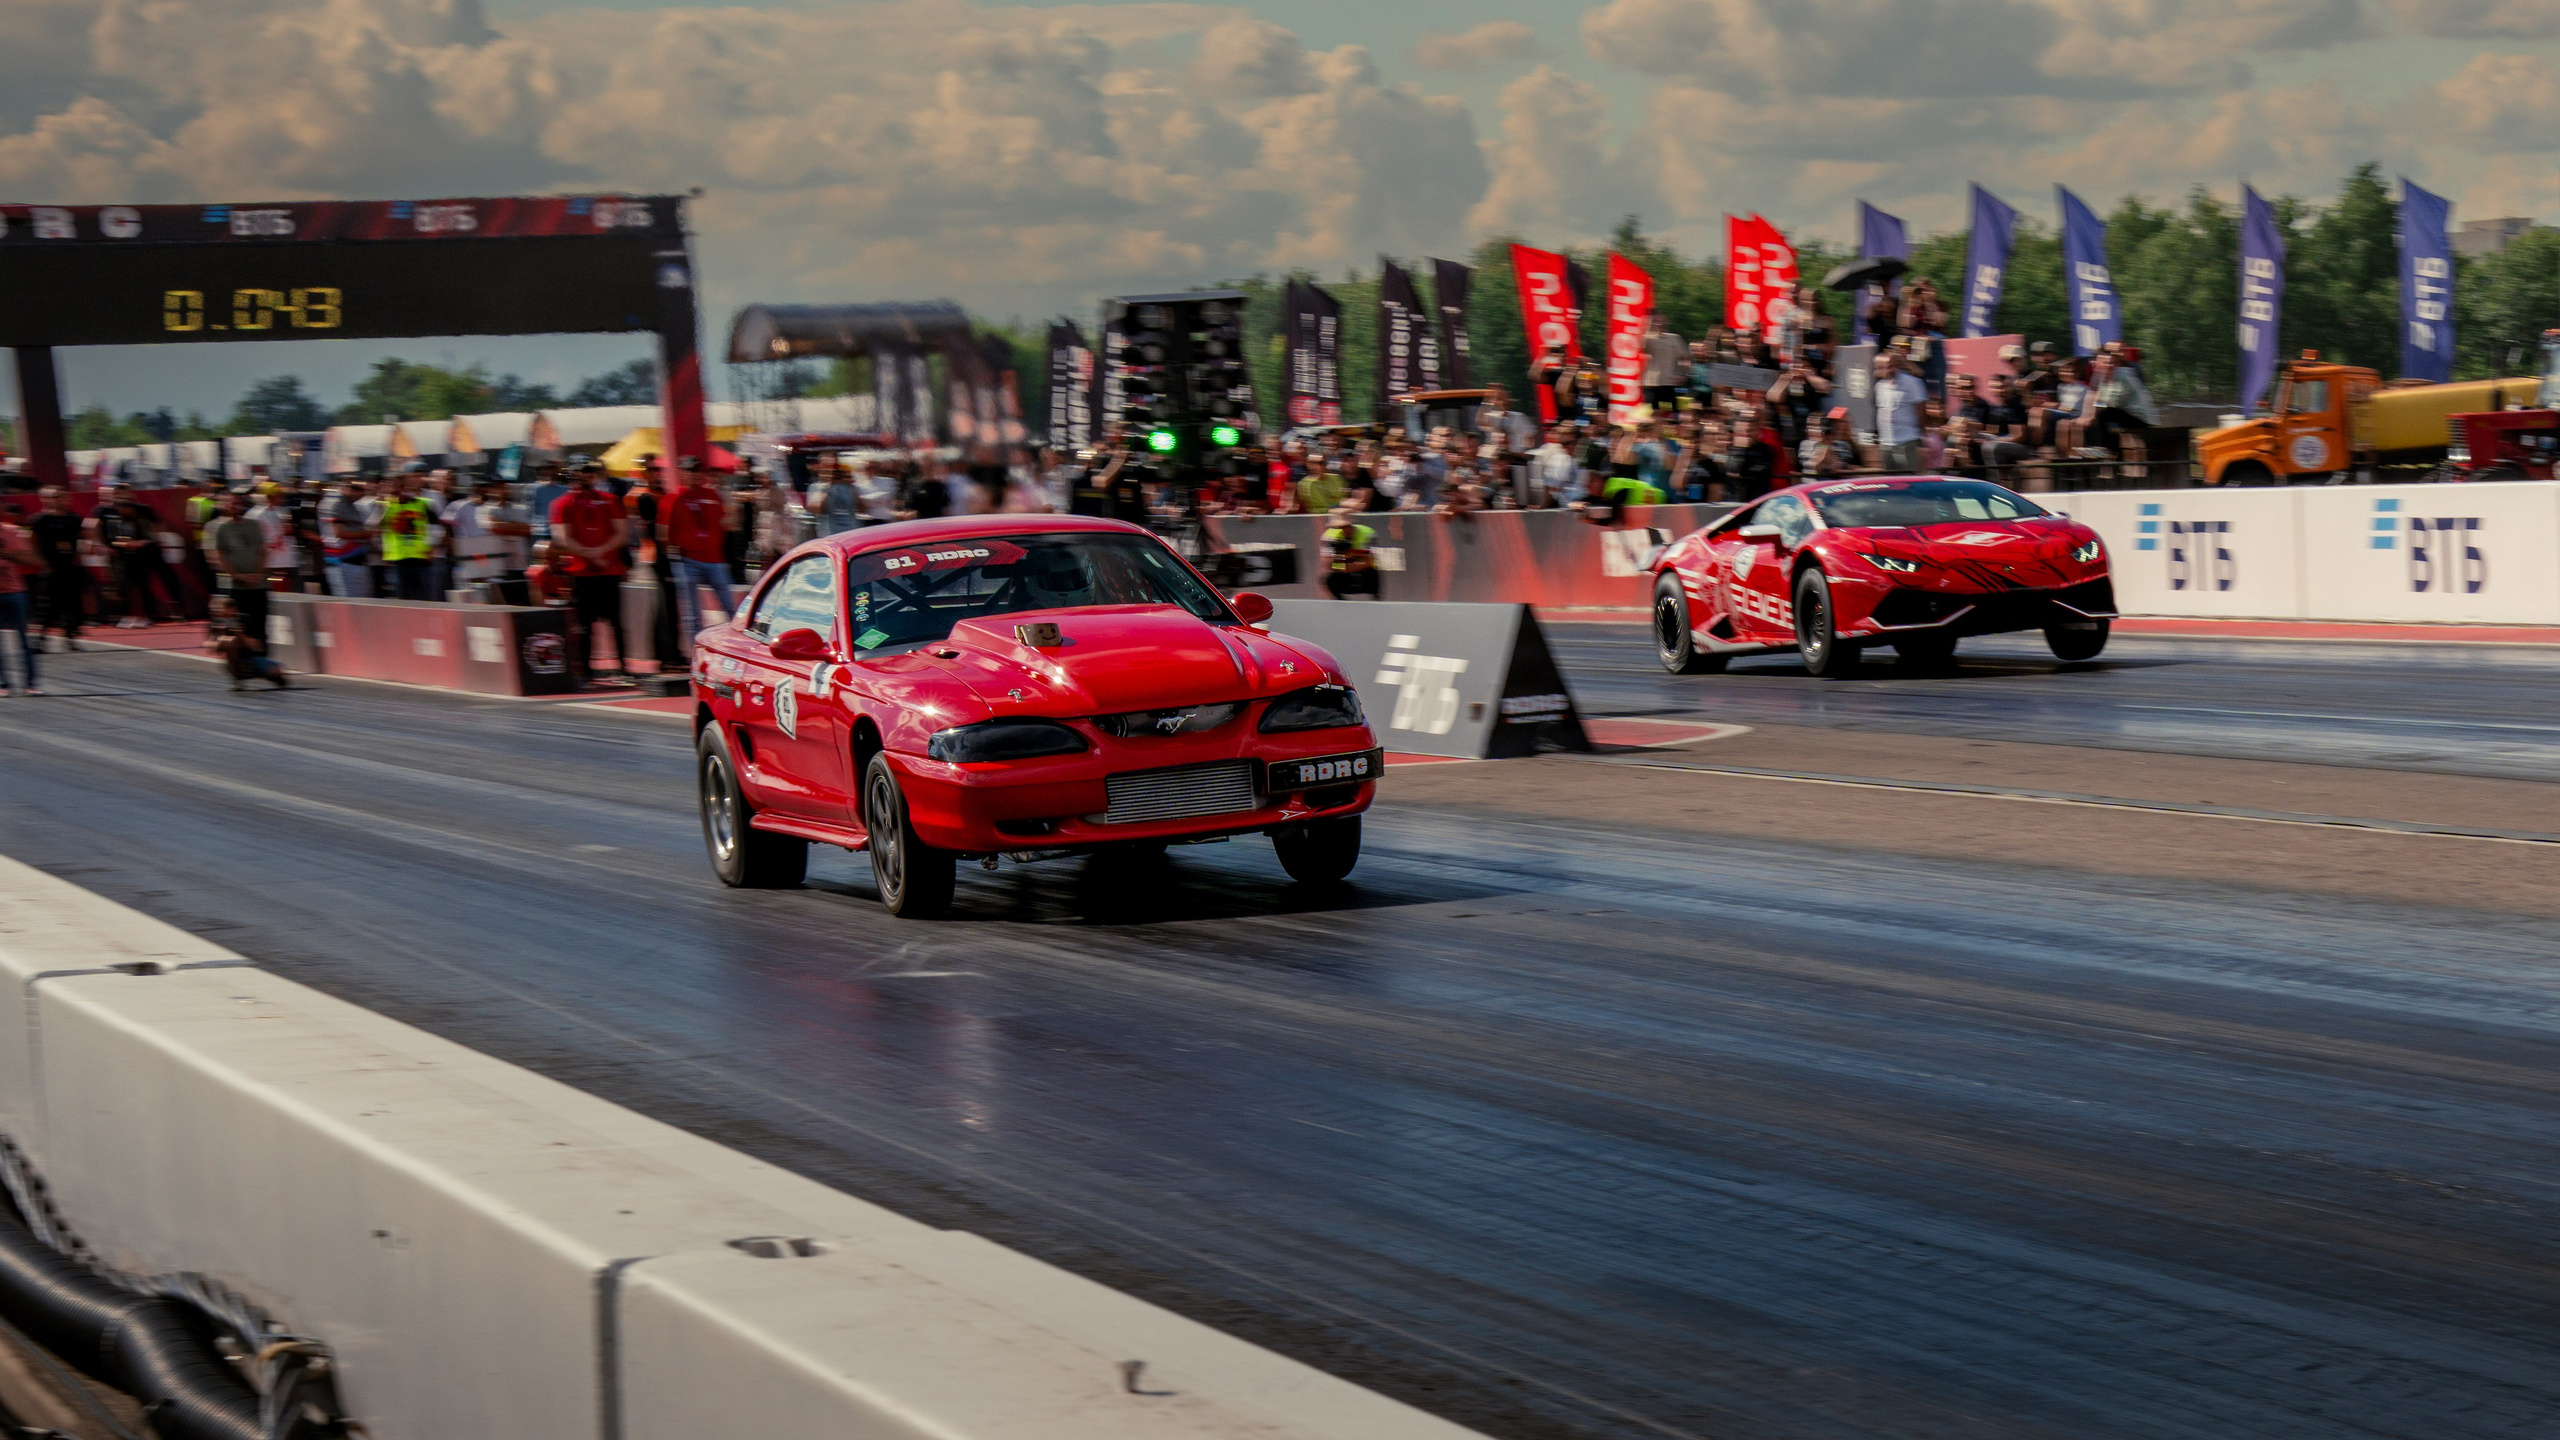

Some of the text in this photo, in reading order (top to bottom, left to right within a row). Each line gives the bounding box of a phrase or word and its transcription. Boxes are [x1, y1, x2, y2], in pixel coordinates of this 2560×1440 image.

[884, 548, 990, 570] 81 RDRC
[2166, 520, 2238, 592] ВТБ
[2406, 517, 2486, 593] ВТБ
[1299, 757, 1368, 782] RDRC
